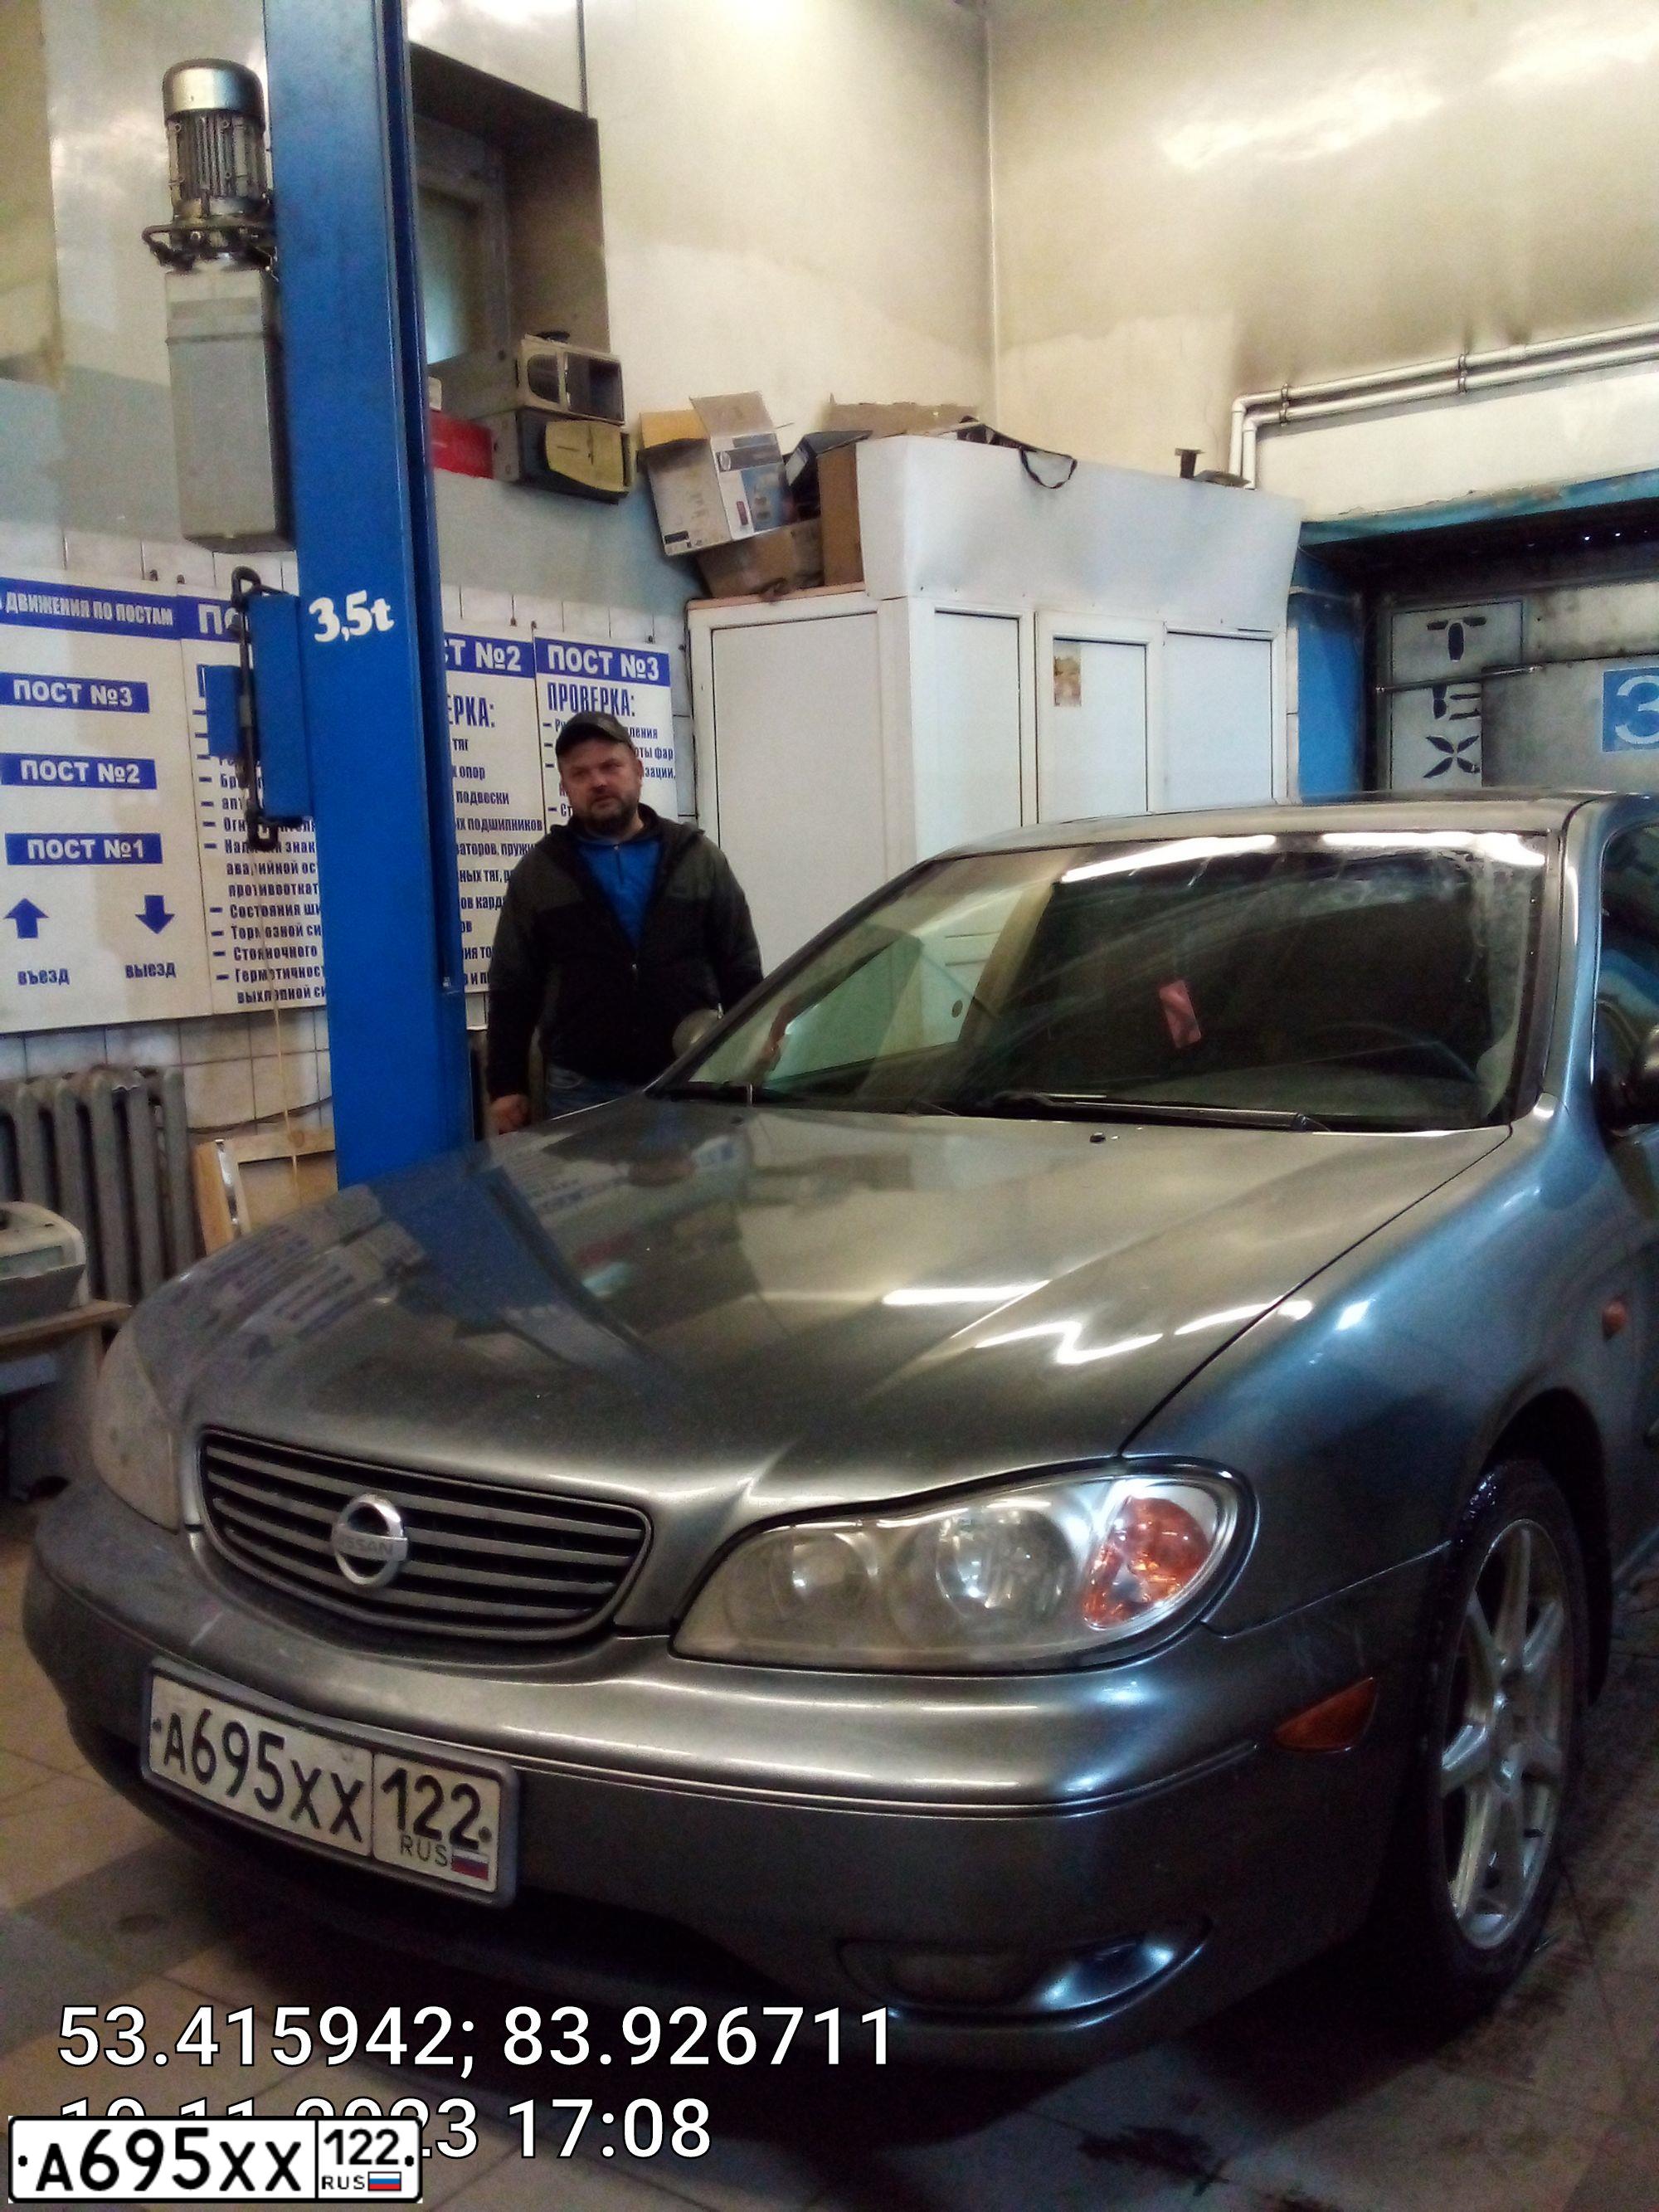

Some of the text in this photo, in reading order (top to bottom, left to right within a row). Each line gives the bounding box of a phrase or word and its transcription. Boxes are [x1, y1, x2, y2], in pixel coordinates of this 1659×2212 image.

[6, 591, 173, 626] ДВИЖЕНИЯ ПО ПОСТАМ
[309, 590, 395, 642] 3,5t
[474, 641, 522, 672] №2
[547, 644, 660, 681] ПОСТ №3
[13, 680, 133, 706] ПОСТ №3
[547, 682, 635, 717] ПРОВЕРКА:
[21, 759, 140, 783] ПОСТ №2
[460, 766, 485, 780] опор
[456, 791, 509, 806] подвески
[27, 839, 144, 860] ПОСТ №1
[381, 1767, 481, 1850] 122
[399, 1834, 449, 1868] RUS
